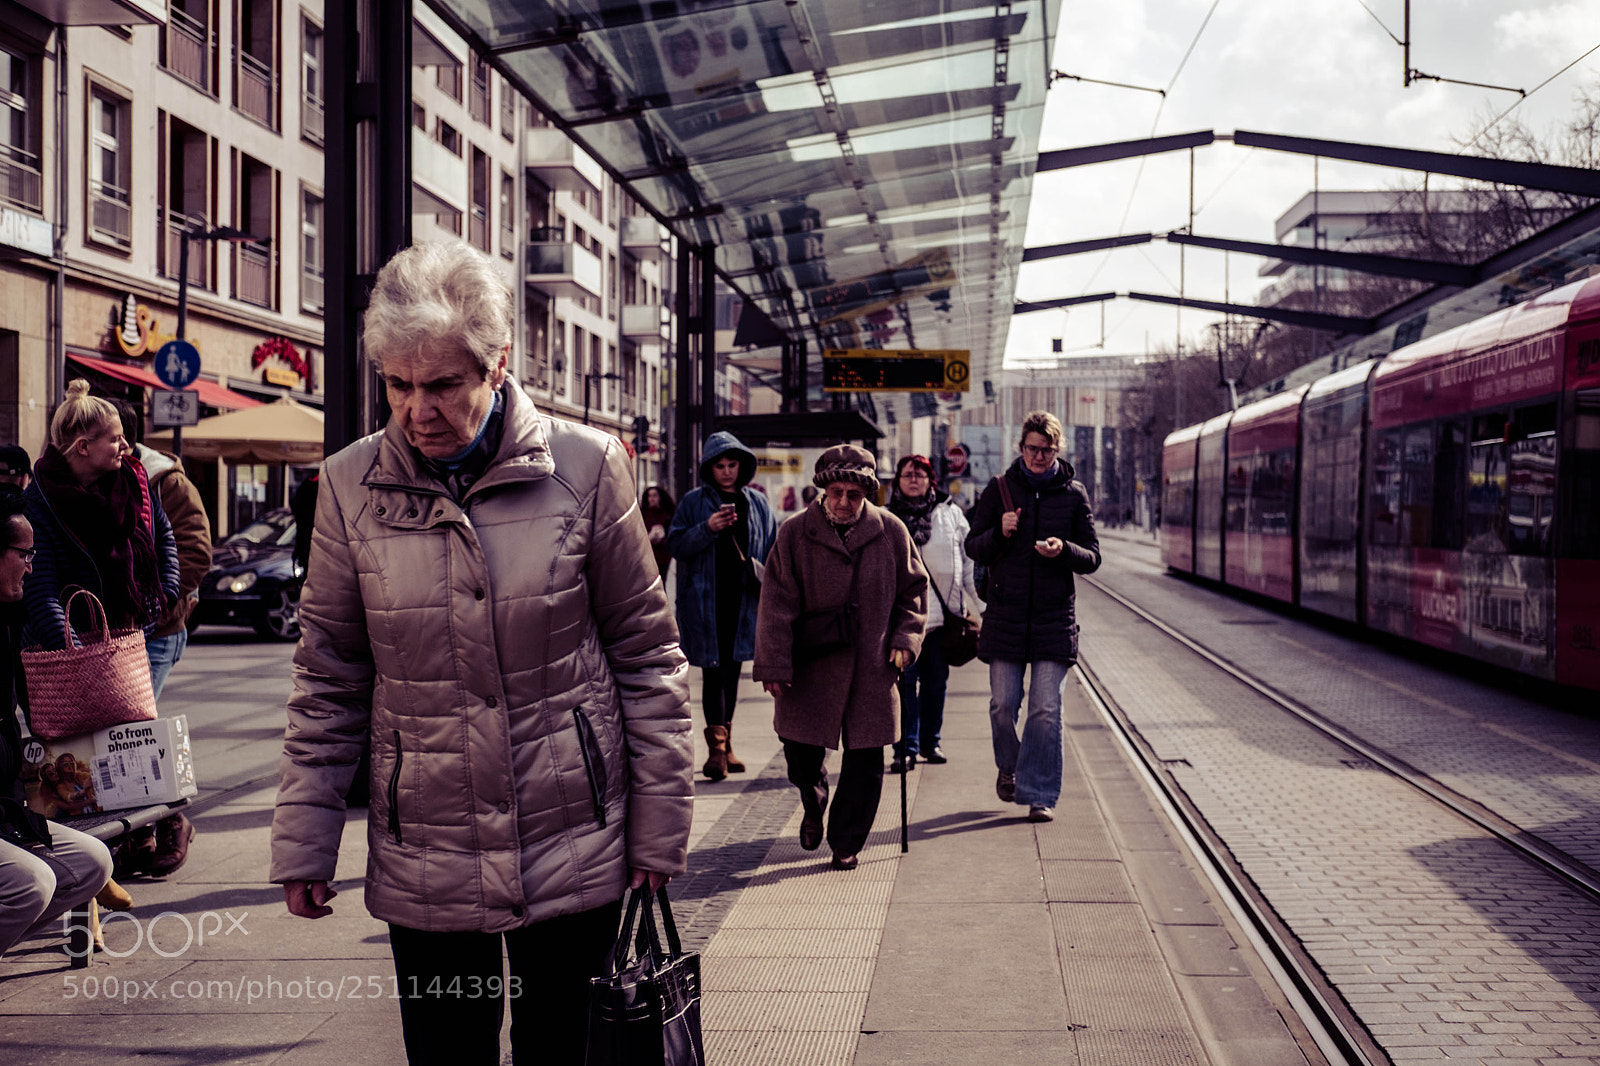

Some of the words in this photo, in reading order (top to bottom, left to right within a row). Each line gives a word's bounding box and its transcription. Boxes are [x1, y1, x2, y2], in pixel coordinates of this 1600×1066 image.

[108, 729, 123, 741] Go
[125, 727, 153, 739] from
[26, 742, 42, 763] hp
[108, 740, 143, 753] phone
